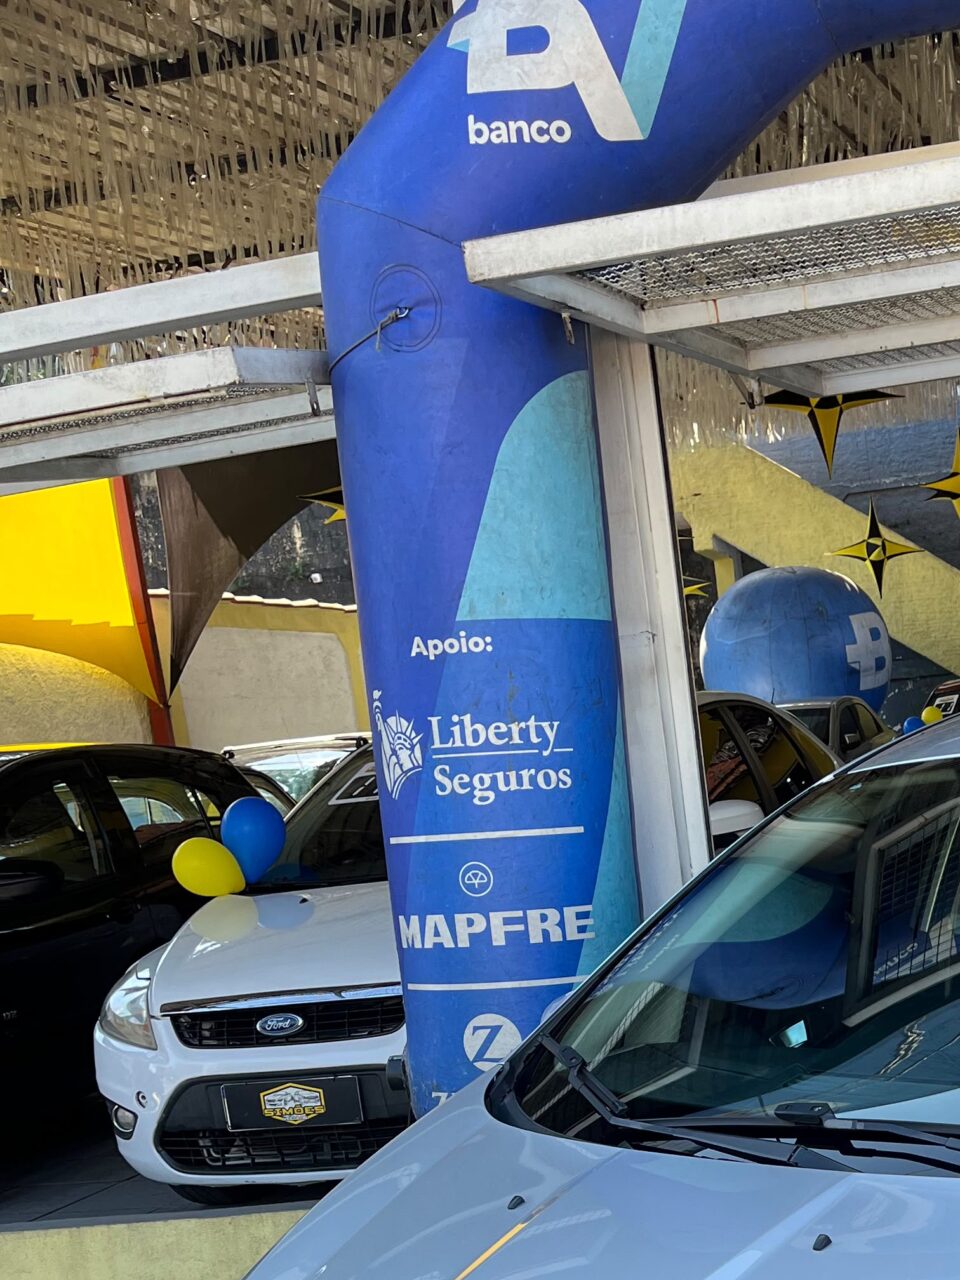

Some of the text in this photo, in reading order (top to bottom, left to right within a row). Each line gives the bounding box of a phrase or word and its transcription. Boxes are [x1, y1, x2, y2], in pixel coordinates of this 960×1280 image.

[468, 114, 572, 145] banco
[411, 630, 493, 660] Apoio:
[427, 713, 561, 757] Liberty
[435, 764, 572, 806] Seguros
[399, 905, 596, 949] MAPFRE
[265, 1016, 291, 1031] Ford
[264, 1104, 325, 1117] SIMÕES
